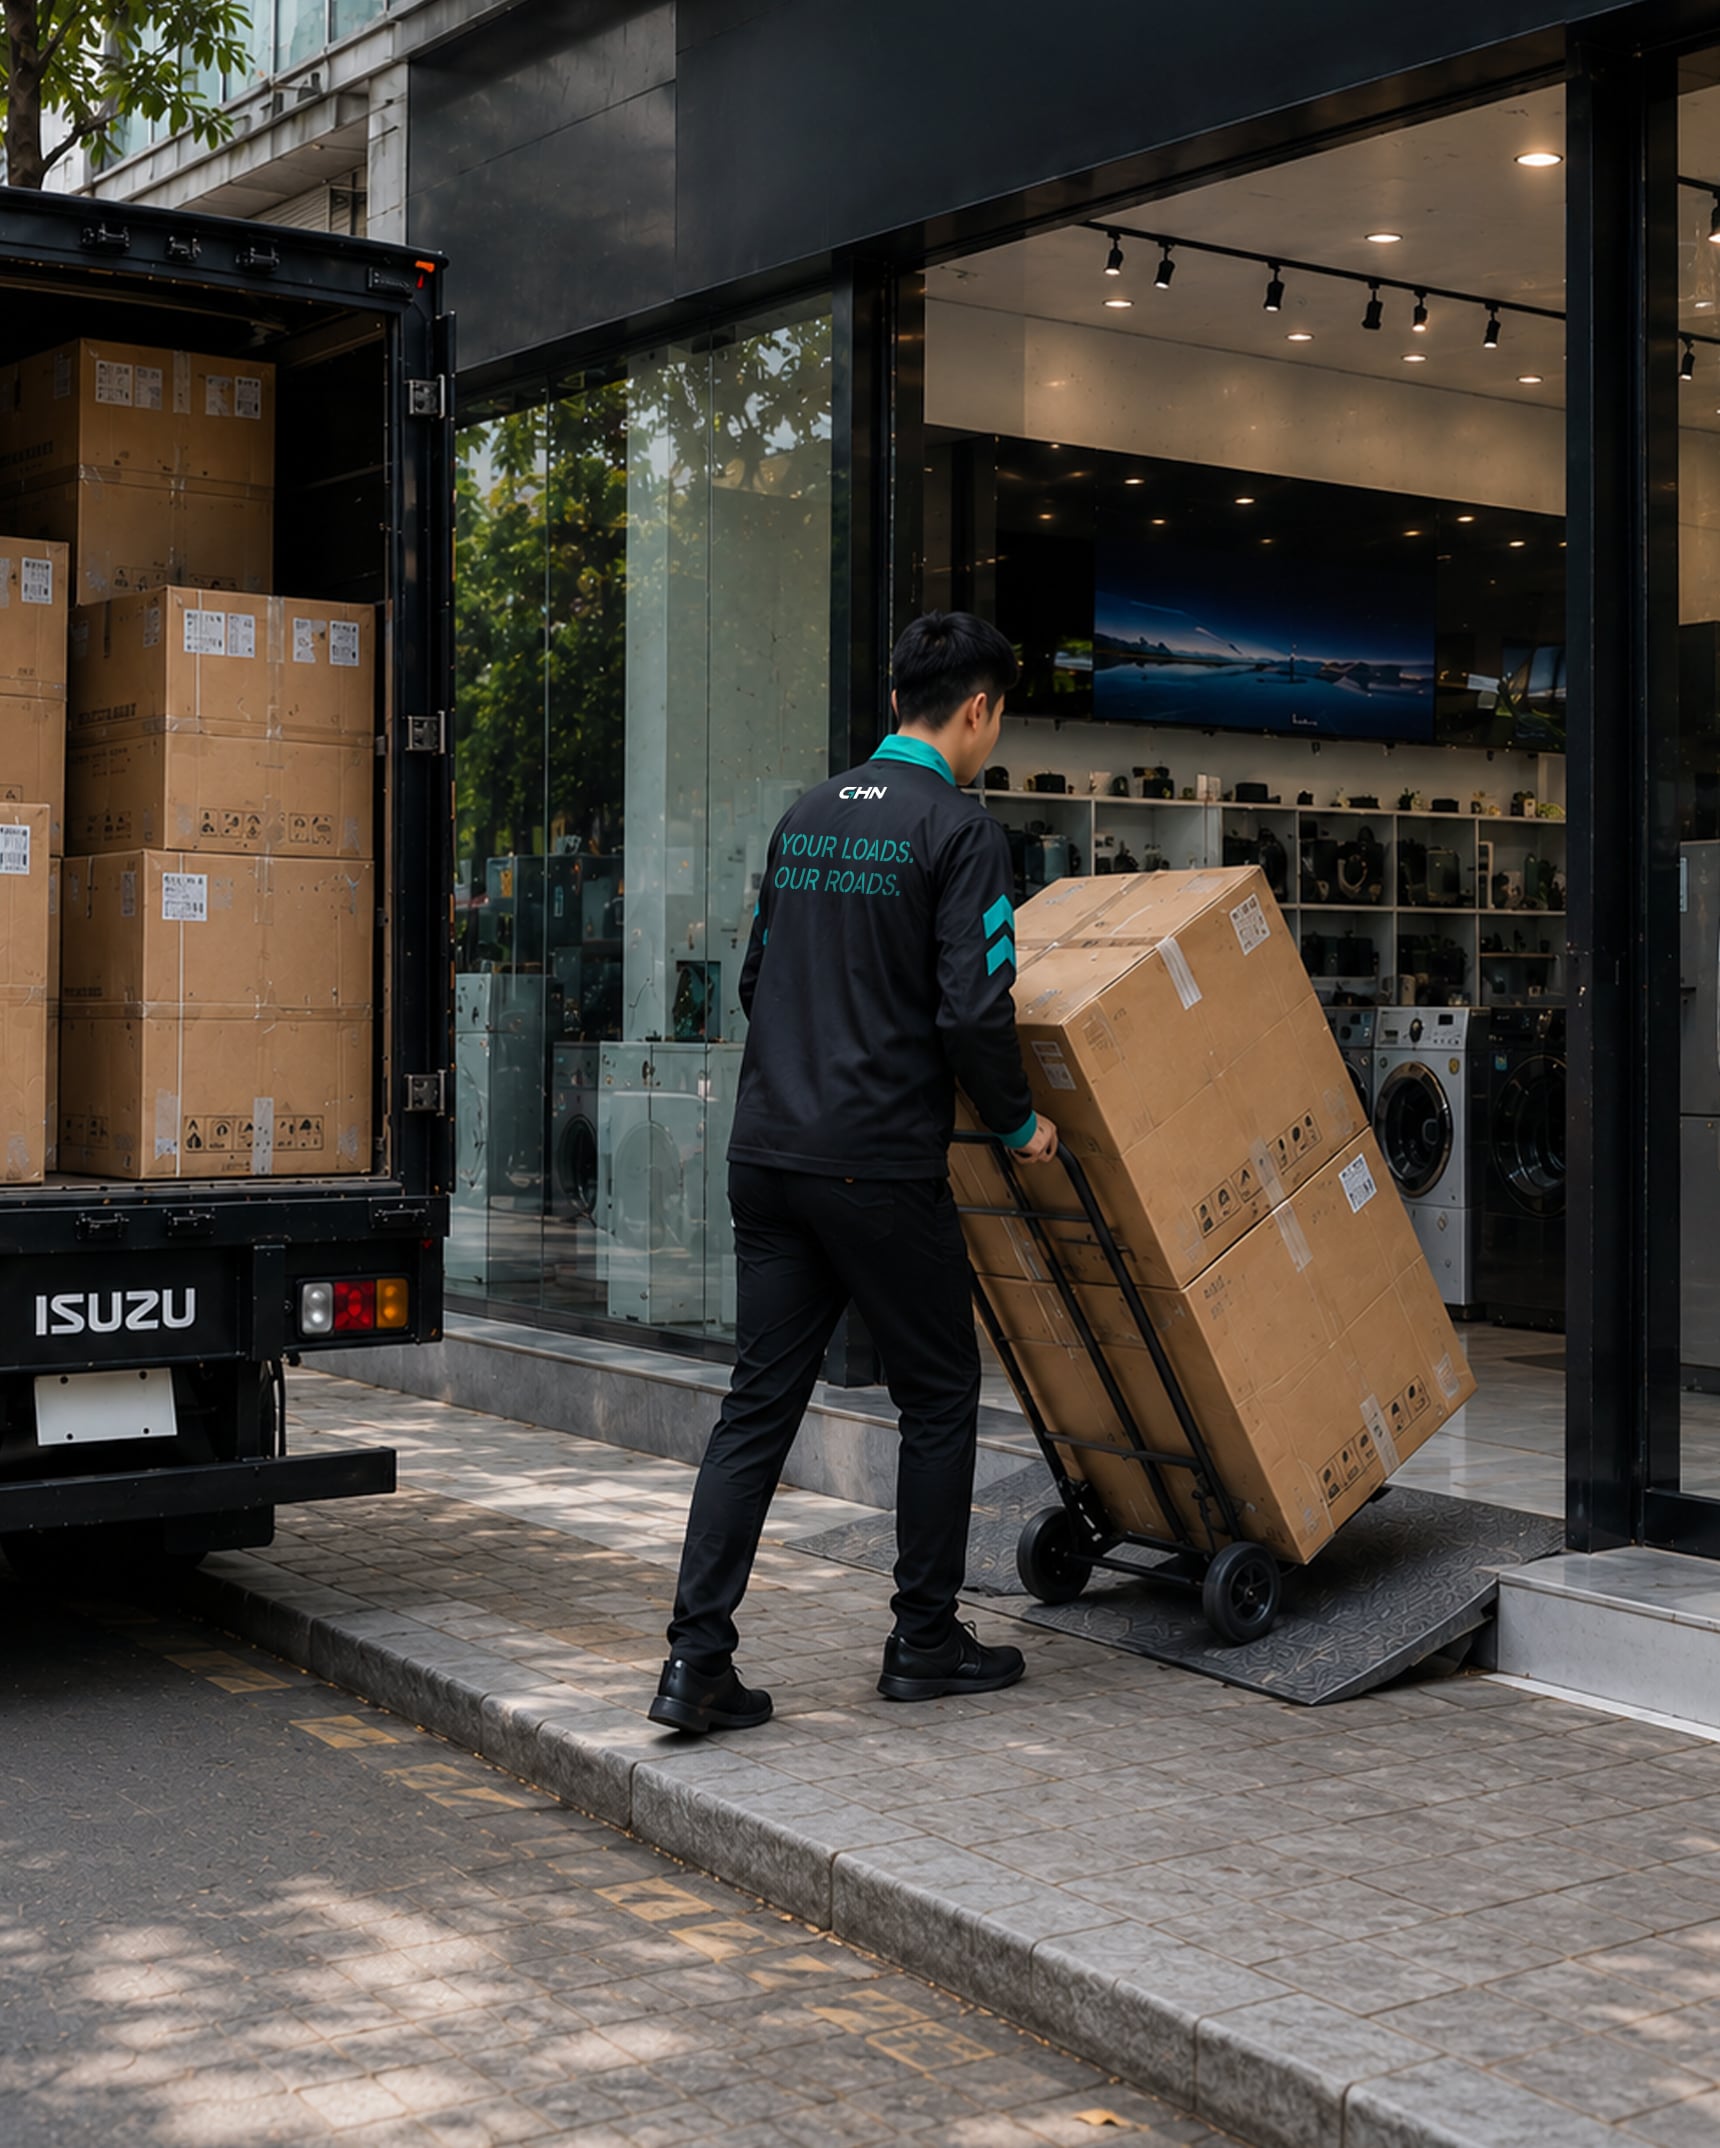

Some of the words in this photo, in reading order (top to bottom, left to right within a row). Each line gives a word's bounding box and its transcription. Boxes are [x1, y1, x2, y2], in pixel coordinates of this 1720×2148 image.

[839, 786, 888, 800] GHN
[781, 832, 838, 858] YOUR
[841, 837, 914, 864] LOADS.
[774, 866, 820, 891] OUR
[824, 870, 900, 896] ROADS.
[35, 1288, 195, 1336] ISUZU
